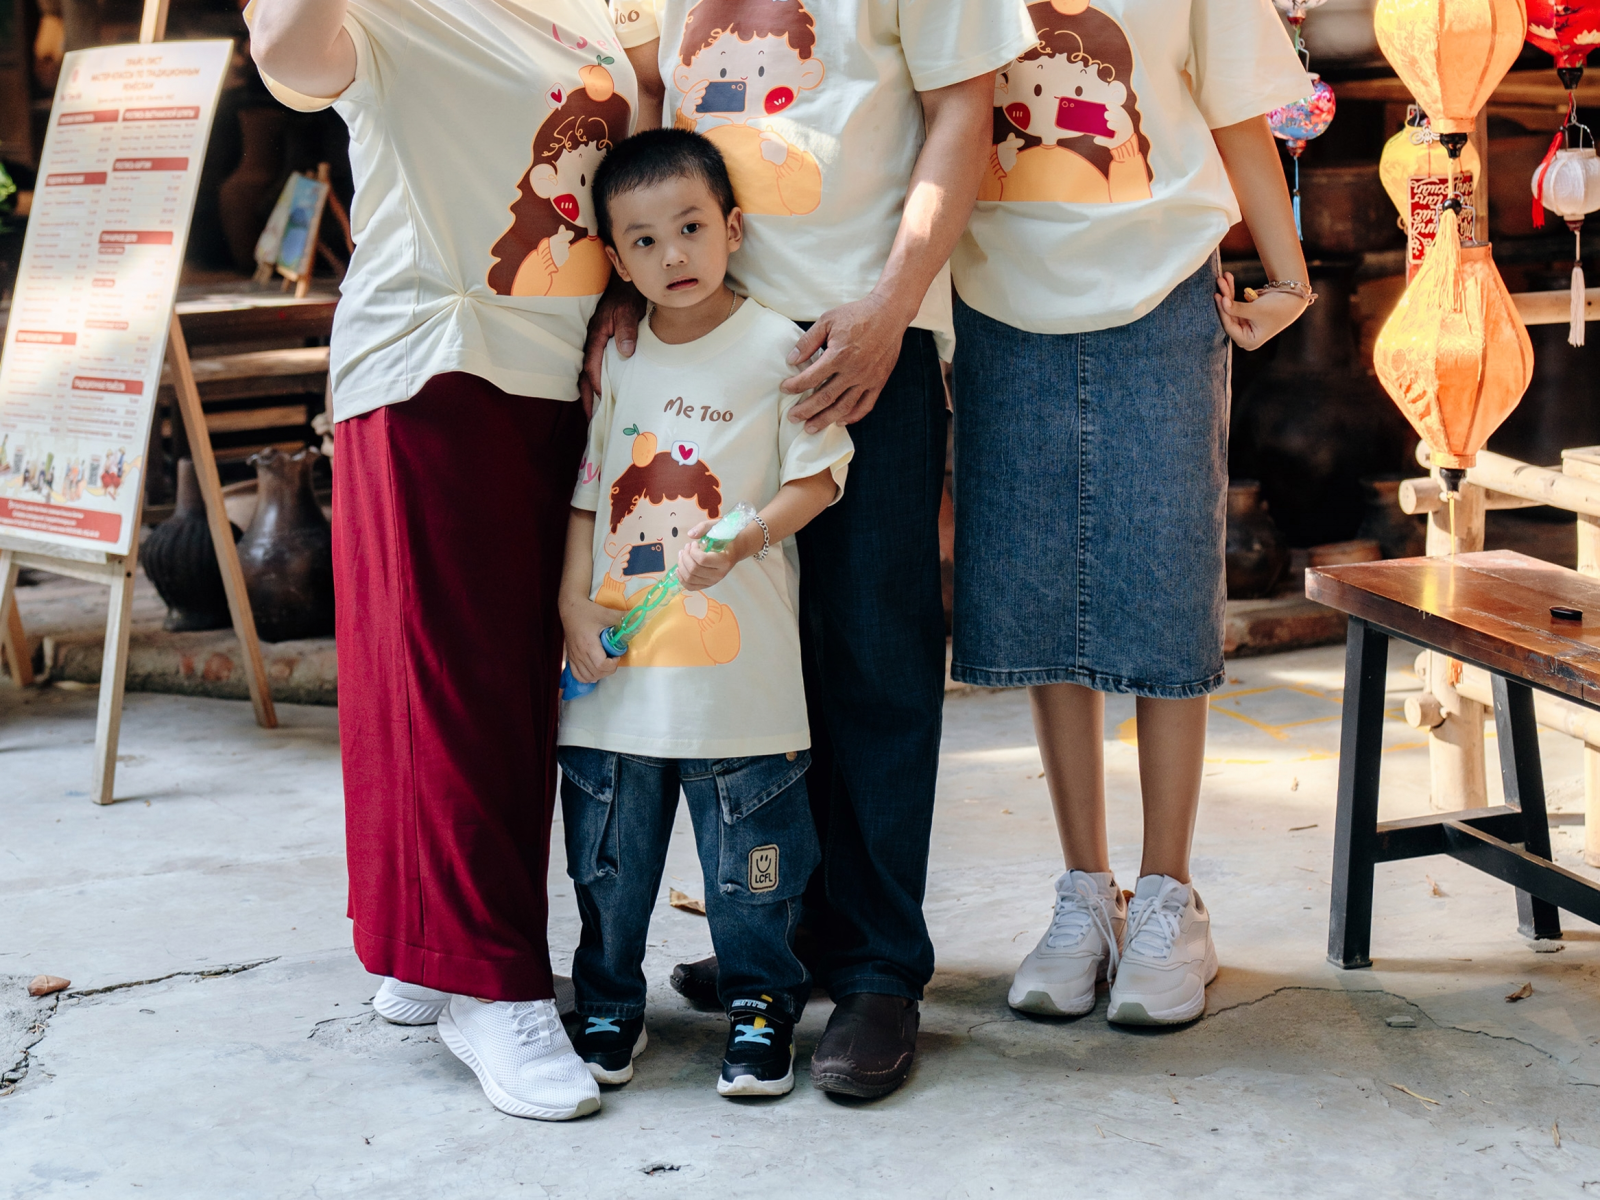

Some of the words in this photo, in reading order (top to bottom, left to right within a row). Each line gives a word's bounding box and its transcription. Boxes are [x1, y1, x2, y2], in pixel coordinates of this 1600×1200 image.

[664, 396, 694, 419] Me
[700, 405, 733, 423] Too
[755, 873, 773, 884] LCFL
